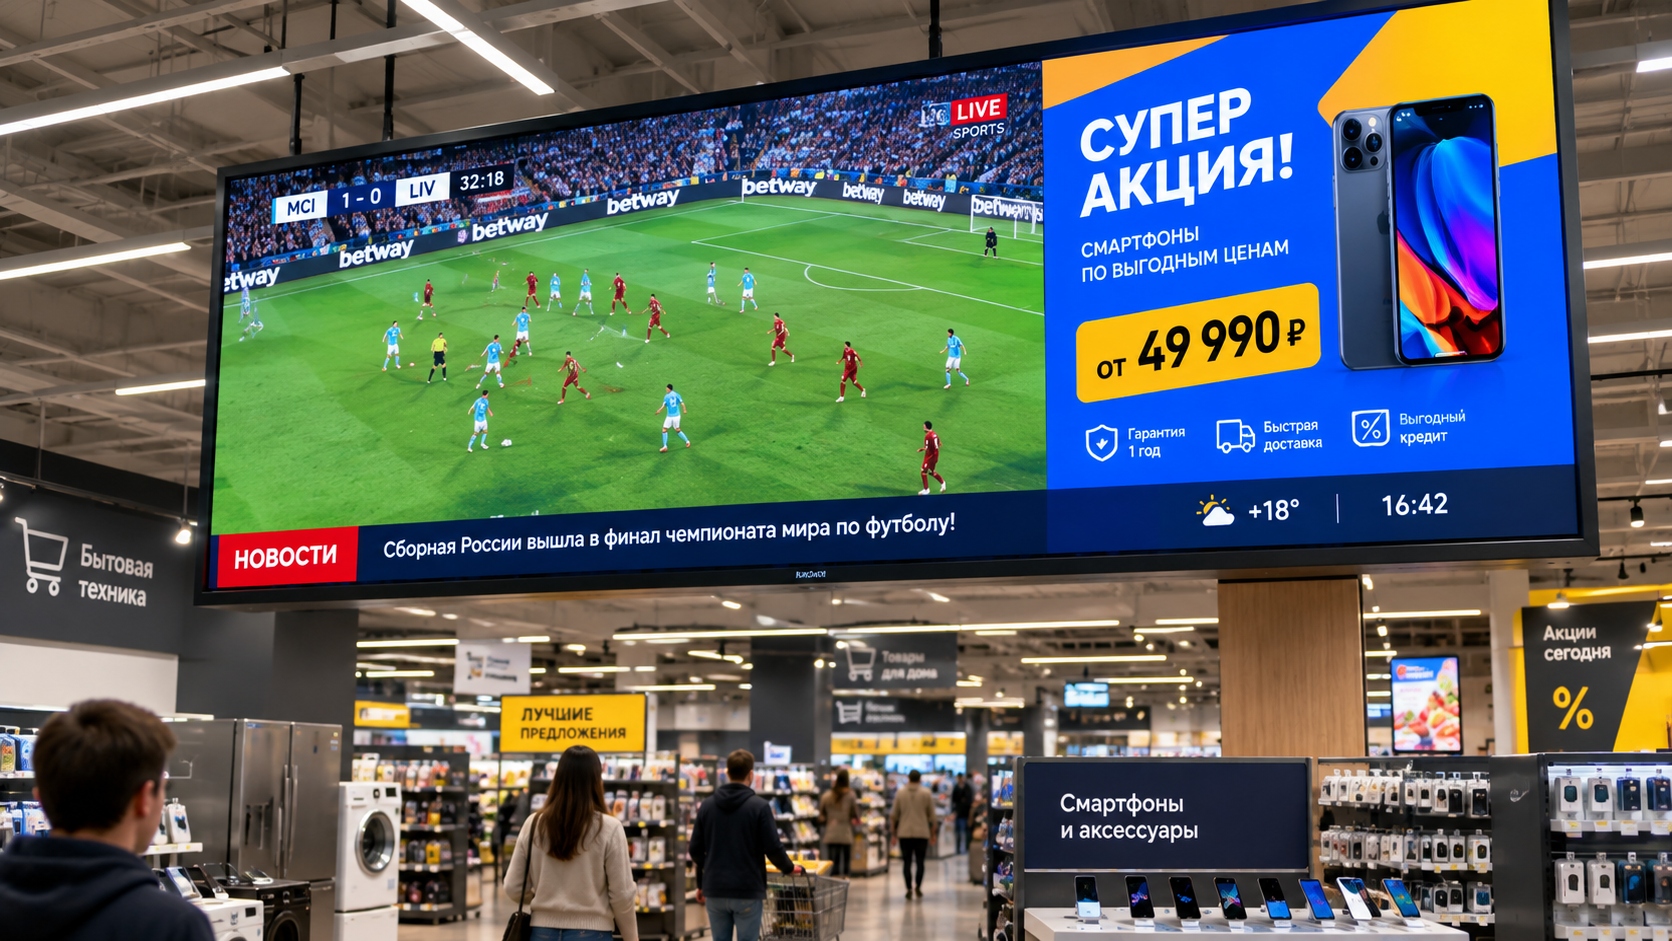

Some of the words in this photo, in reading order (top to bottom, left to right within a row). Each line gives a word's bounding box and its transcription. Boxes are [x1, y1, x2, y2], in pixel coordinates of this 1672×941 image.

[957, 98, 1001, 120] LIVE
[953, 122, 1005, 139] SPORTS
[1080, 87, 1251, 162] СУПЕР
[1079, 132, 1293, 218] АКЦИЯ!
[287, 198, 315, 217] MCI
[342, 192, 349, 208] 1
[371, 188, 381, 205] 0
[409, 180, 436, 199] LIV
[460, 170, 504, 191] 32:18
[224, 266, 281, 292] etway
[339, 239, 414, 268] betway
[472, 212, 549, 241] betway
[607, 189, 680, 215] betway
[742, 177, 817, 197] betway
[842, 181, 885, 205] betway
[903, 188, 946, 212] betway
[1081, 226, 1199, 258] СМАРТФОНЫ
[1082, 265, 1107, 282] ПО
[1112, 249, 1218, 279] ВЫГОДНЫМ
[1224, 239, 1289, 265] ЦЕНАМ
[1097, 358, 1127, 379] от
[1138, 325, 1191, 371] 49
[1201, 310, 1280, 362] 990
[1287, 318, 1306, 346] ₽
[1400, 409, 1466, 426] Выгодный
[1128, 427, 1186, 443] Гарантия
[1263, 421, 1319, 438] Быстрая
[1400, 431, 1448, 445] кредит
[1129, 445, 1135, 458] 1
[1139, 445, 1161, 459] год
[1263, 438, 1323, 453] доставка
[1248, 498, 1300, 521] +18°
[1382, 492, 1448, 516] 16:42
[383, 540, 456, 560] Сборная
[461, 536, 522, 554] России
[527, 533, 585, 550] вышла
[589, 533, 599, 547] в
[604, 528, 661, 550] финал
[666, 523, 776, 543] чемпионата
[782, 521, 830, 541] мира
[836, 520, 860, 535] по
[865, 512, 955, 539] футболу!
[80, 543, 153, 579] Бытовая
[234, 544, 337, 570] НОВОСТИ
[78, 579, 147, 607] техника
[1543, 625, 1597, 643] Акции
[882, 650, 925, 664] Товары
[1544, 643, 1612, 662] сегодня
[521, 707, 593, 721] ЛУЧШИЕ
[520, 727, 627, 742] ПРЕДЛОЖЕНИЯ
[1060, 793, 1184, 817] Смартфоны
[1061, 825, 1073, 840] и
[1079, 823, 1198, 844] аксессуары
